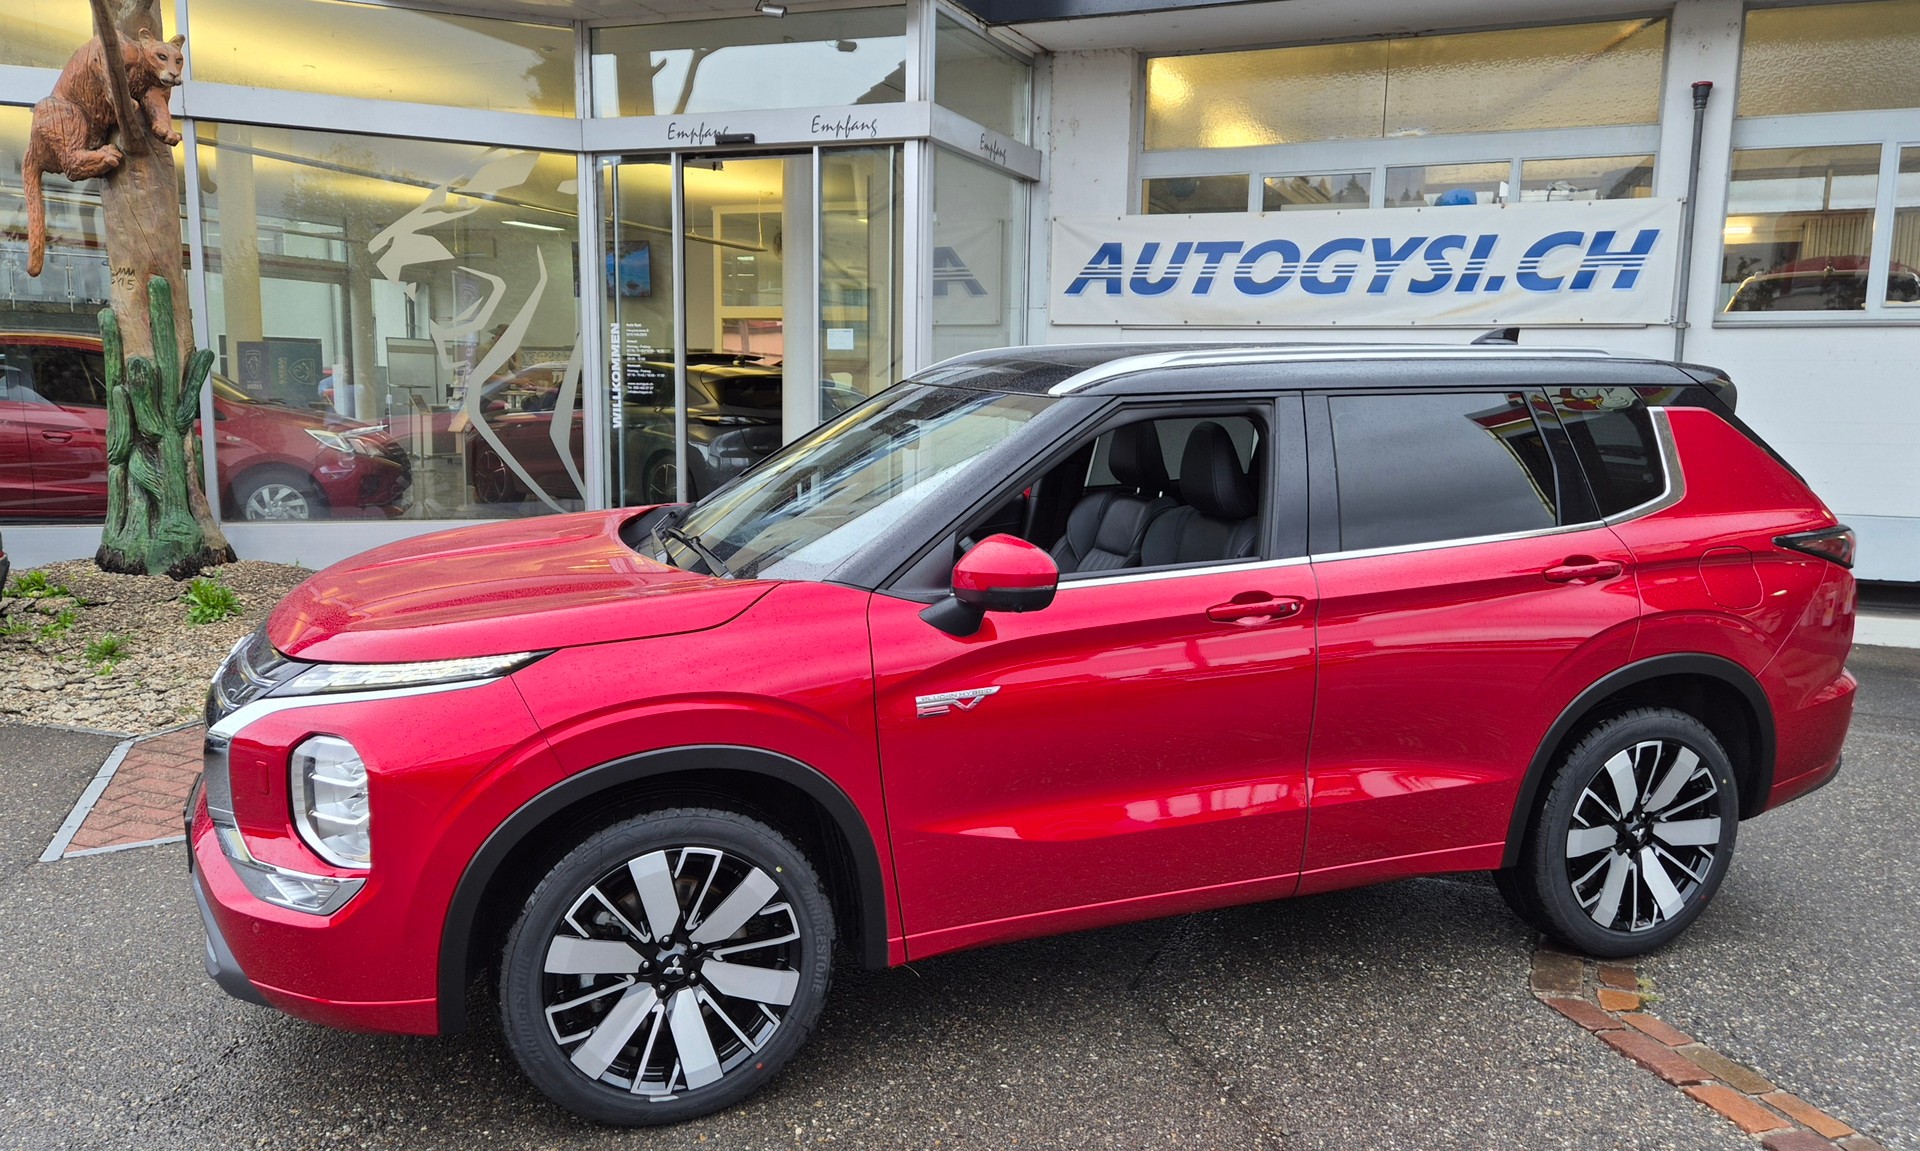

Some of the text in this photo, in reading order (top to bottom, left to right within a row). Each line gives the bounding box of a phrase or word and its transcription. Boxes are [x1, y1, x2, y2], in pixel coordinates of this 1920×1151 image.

[811, 114, 879, 138] Empfang
[980, 133, 1007, 166] Empfang
[1063, 229, 1660, 296] AUTOGYSI.CH
[610, 322, 623, 430] WILLKOMMEN
